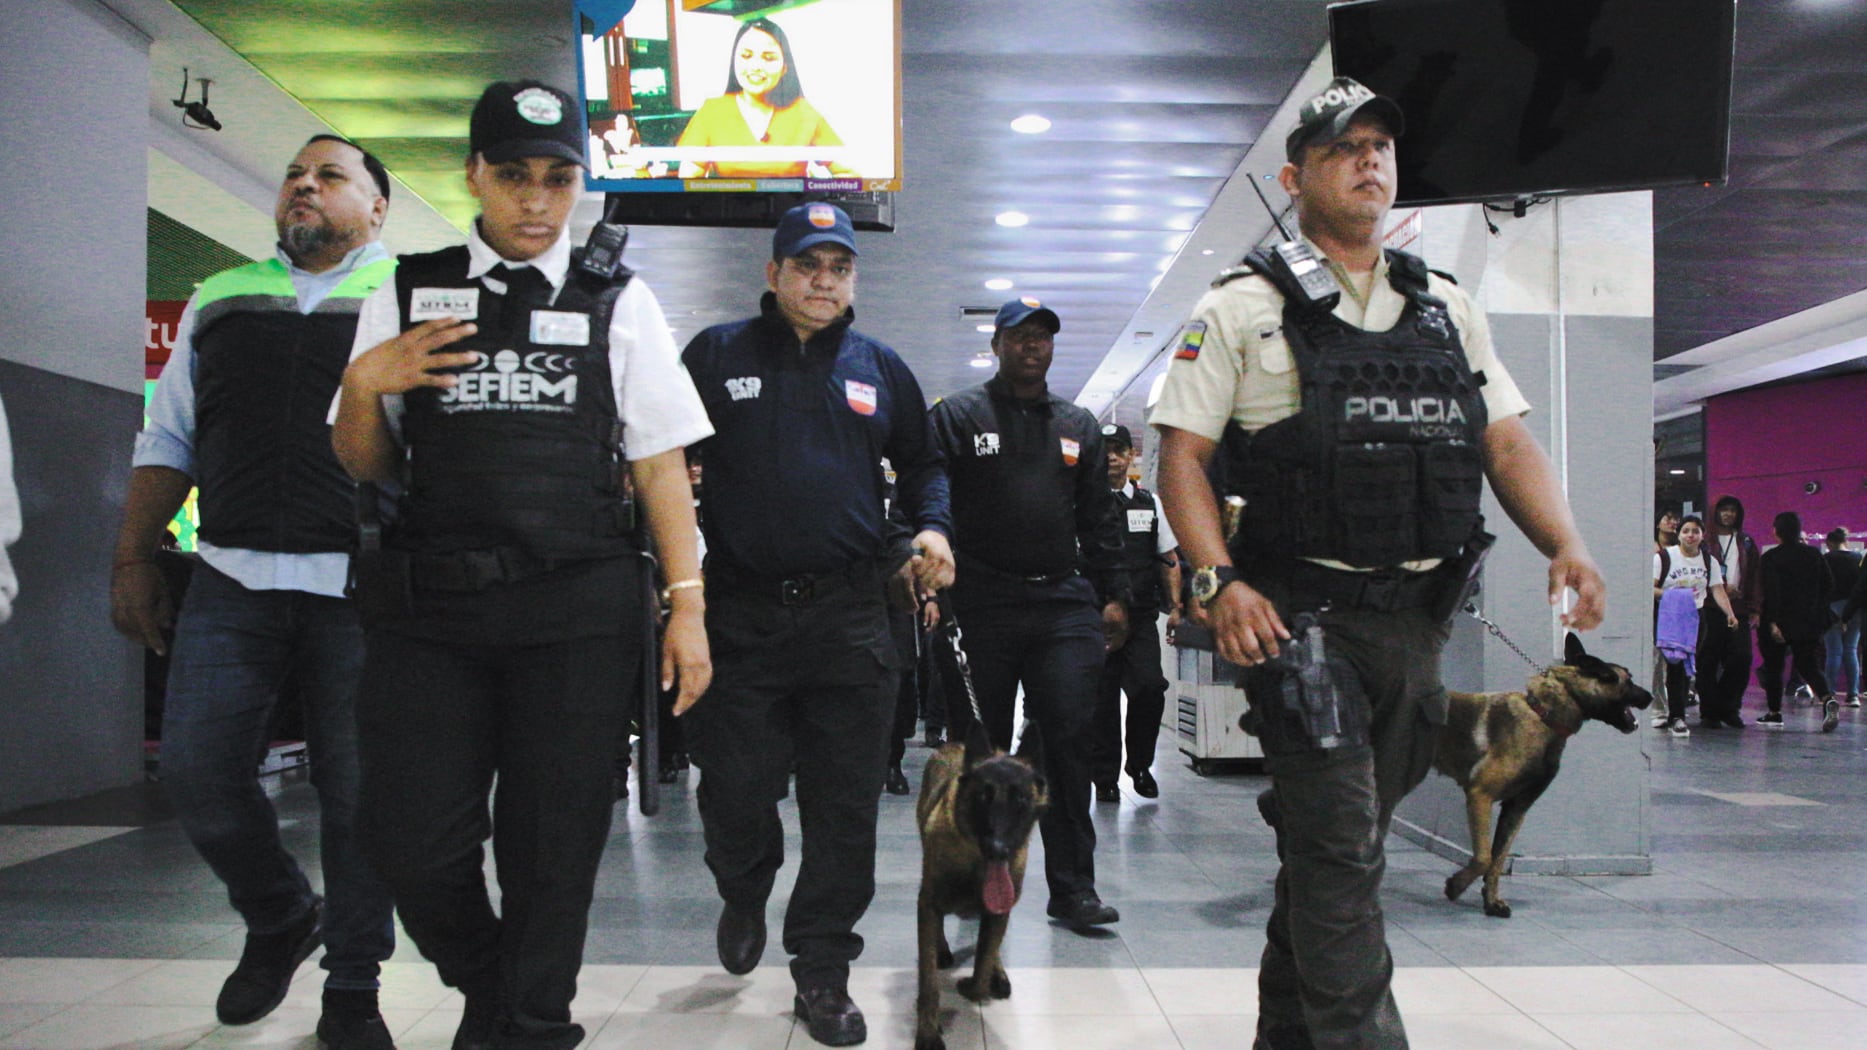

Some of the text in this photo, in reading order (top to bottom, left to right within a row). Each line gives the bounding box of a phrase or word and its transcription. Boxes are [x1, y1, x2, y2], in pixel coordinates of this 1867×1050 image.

[807, 181, 858, 190] Conectividad
[1345, 396, 1467, 424] POLICIA
[973, 432, 1000, 448] K9
[976, 445, 1000, 456] UNIT
